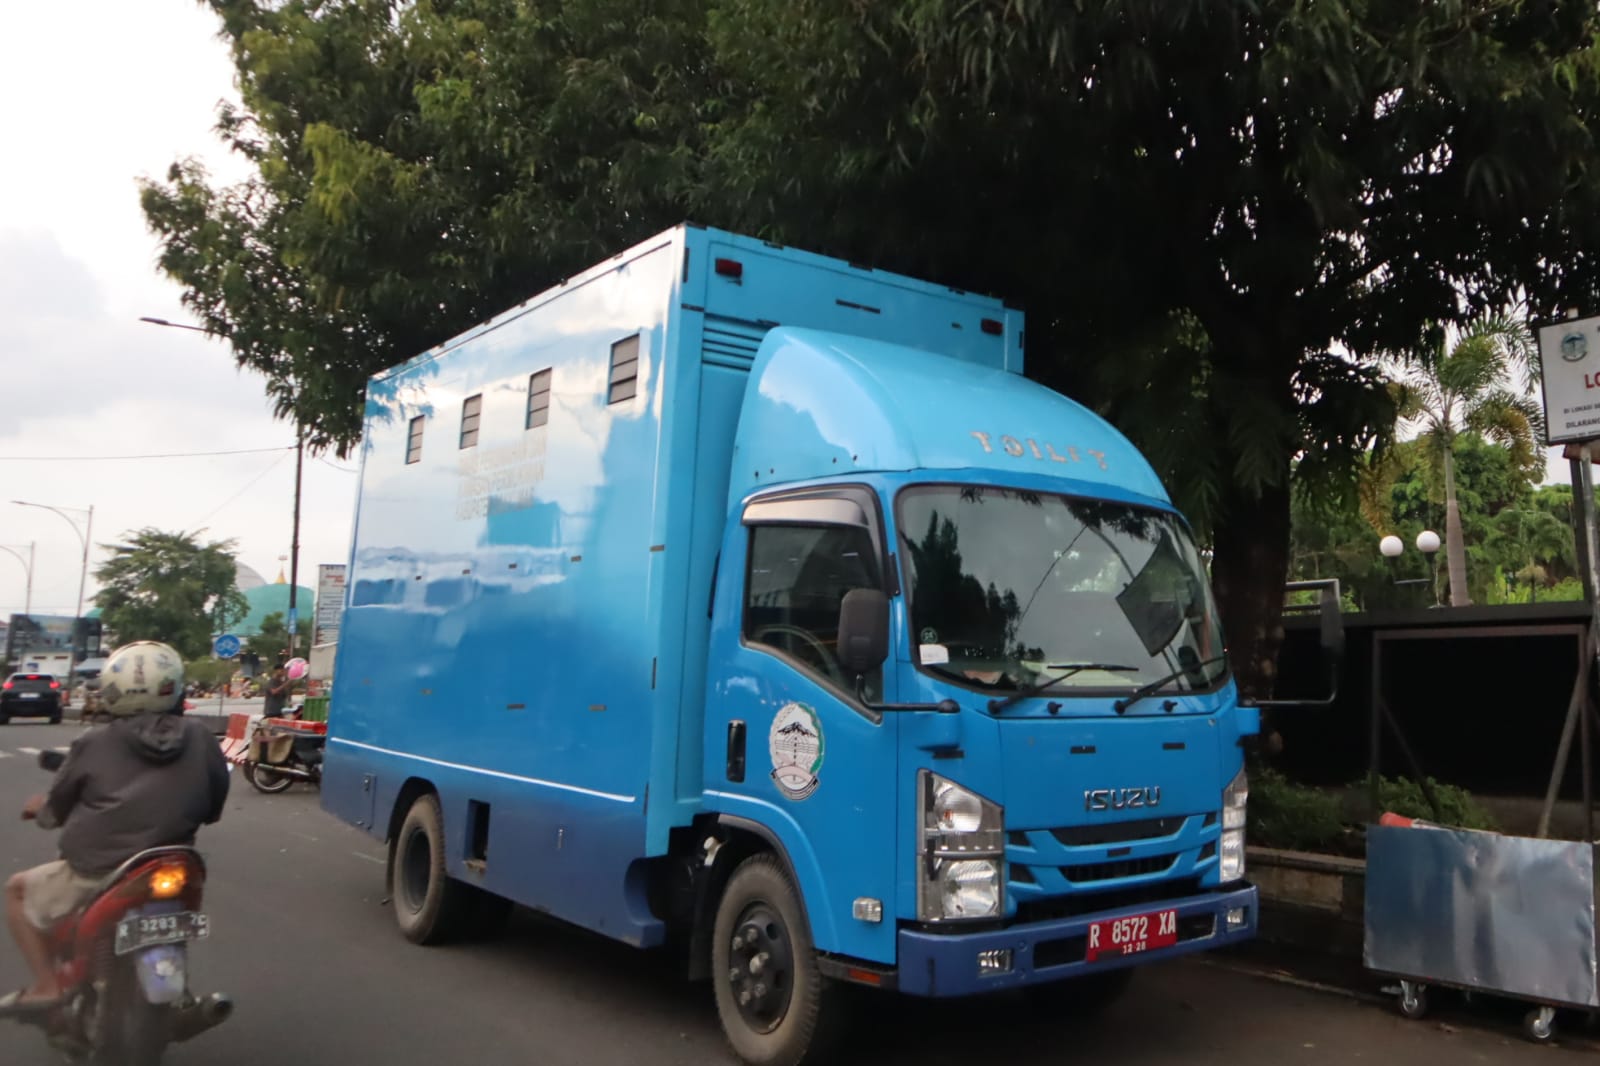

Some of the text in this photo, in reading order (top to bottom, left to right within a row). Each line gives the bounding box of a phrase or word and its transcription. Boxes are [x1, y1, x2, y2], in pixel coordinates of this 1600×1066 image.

[1083, 786, 1160, 811] ISUZU
[1089, 911, 1176, 949] R 8572 XA
